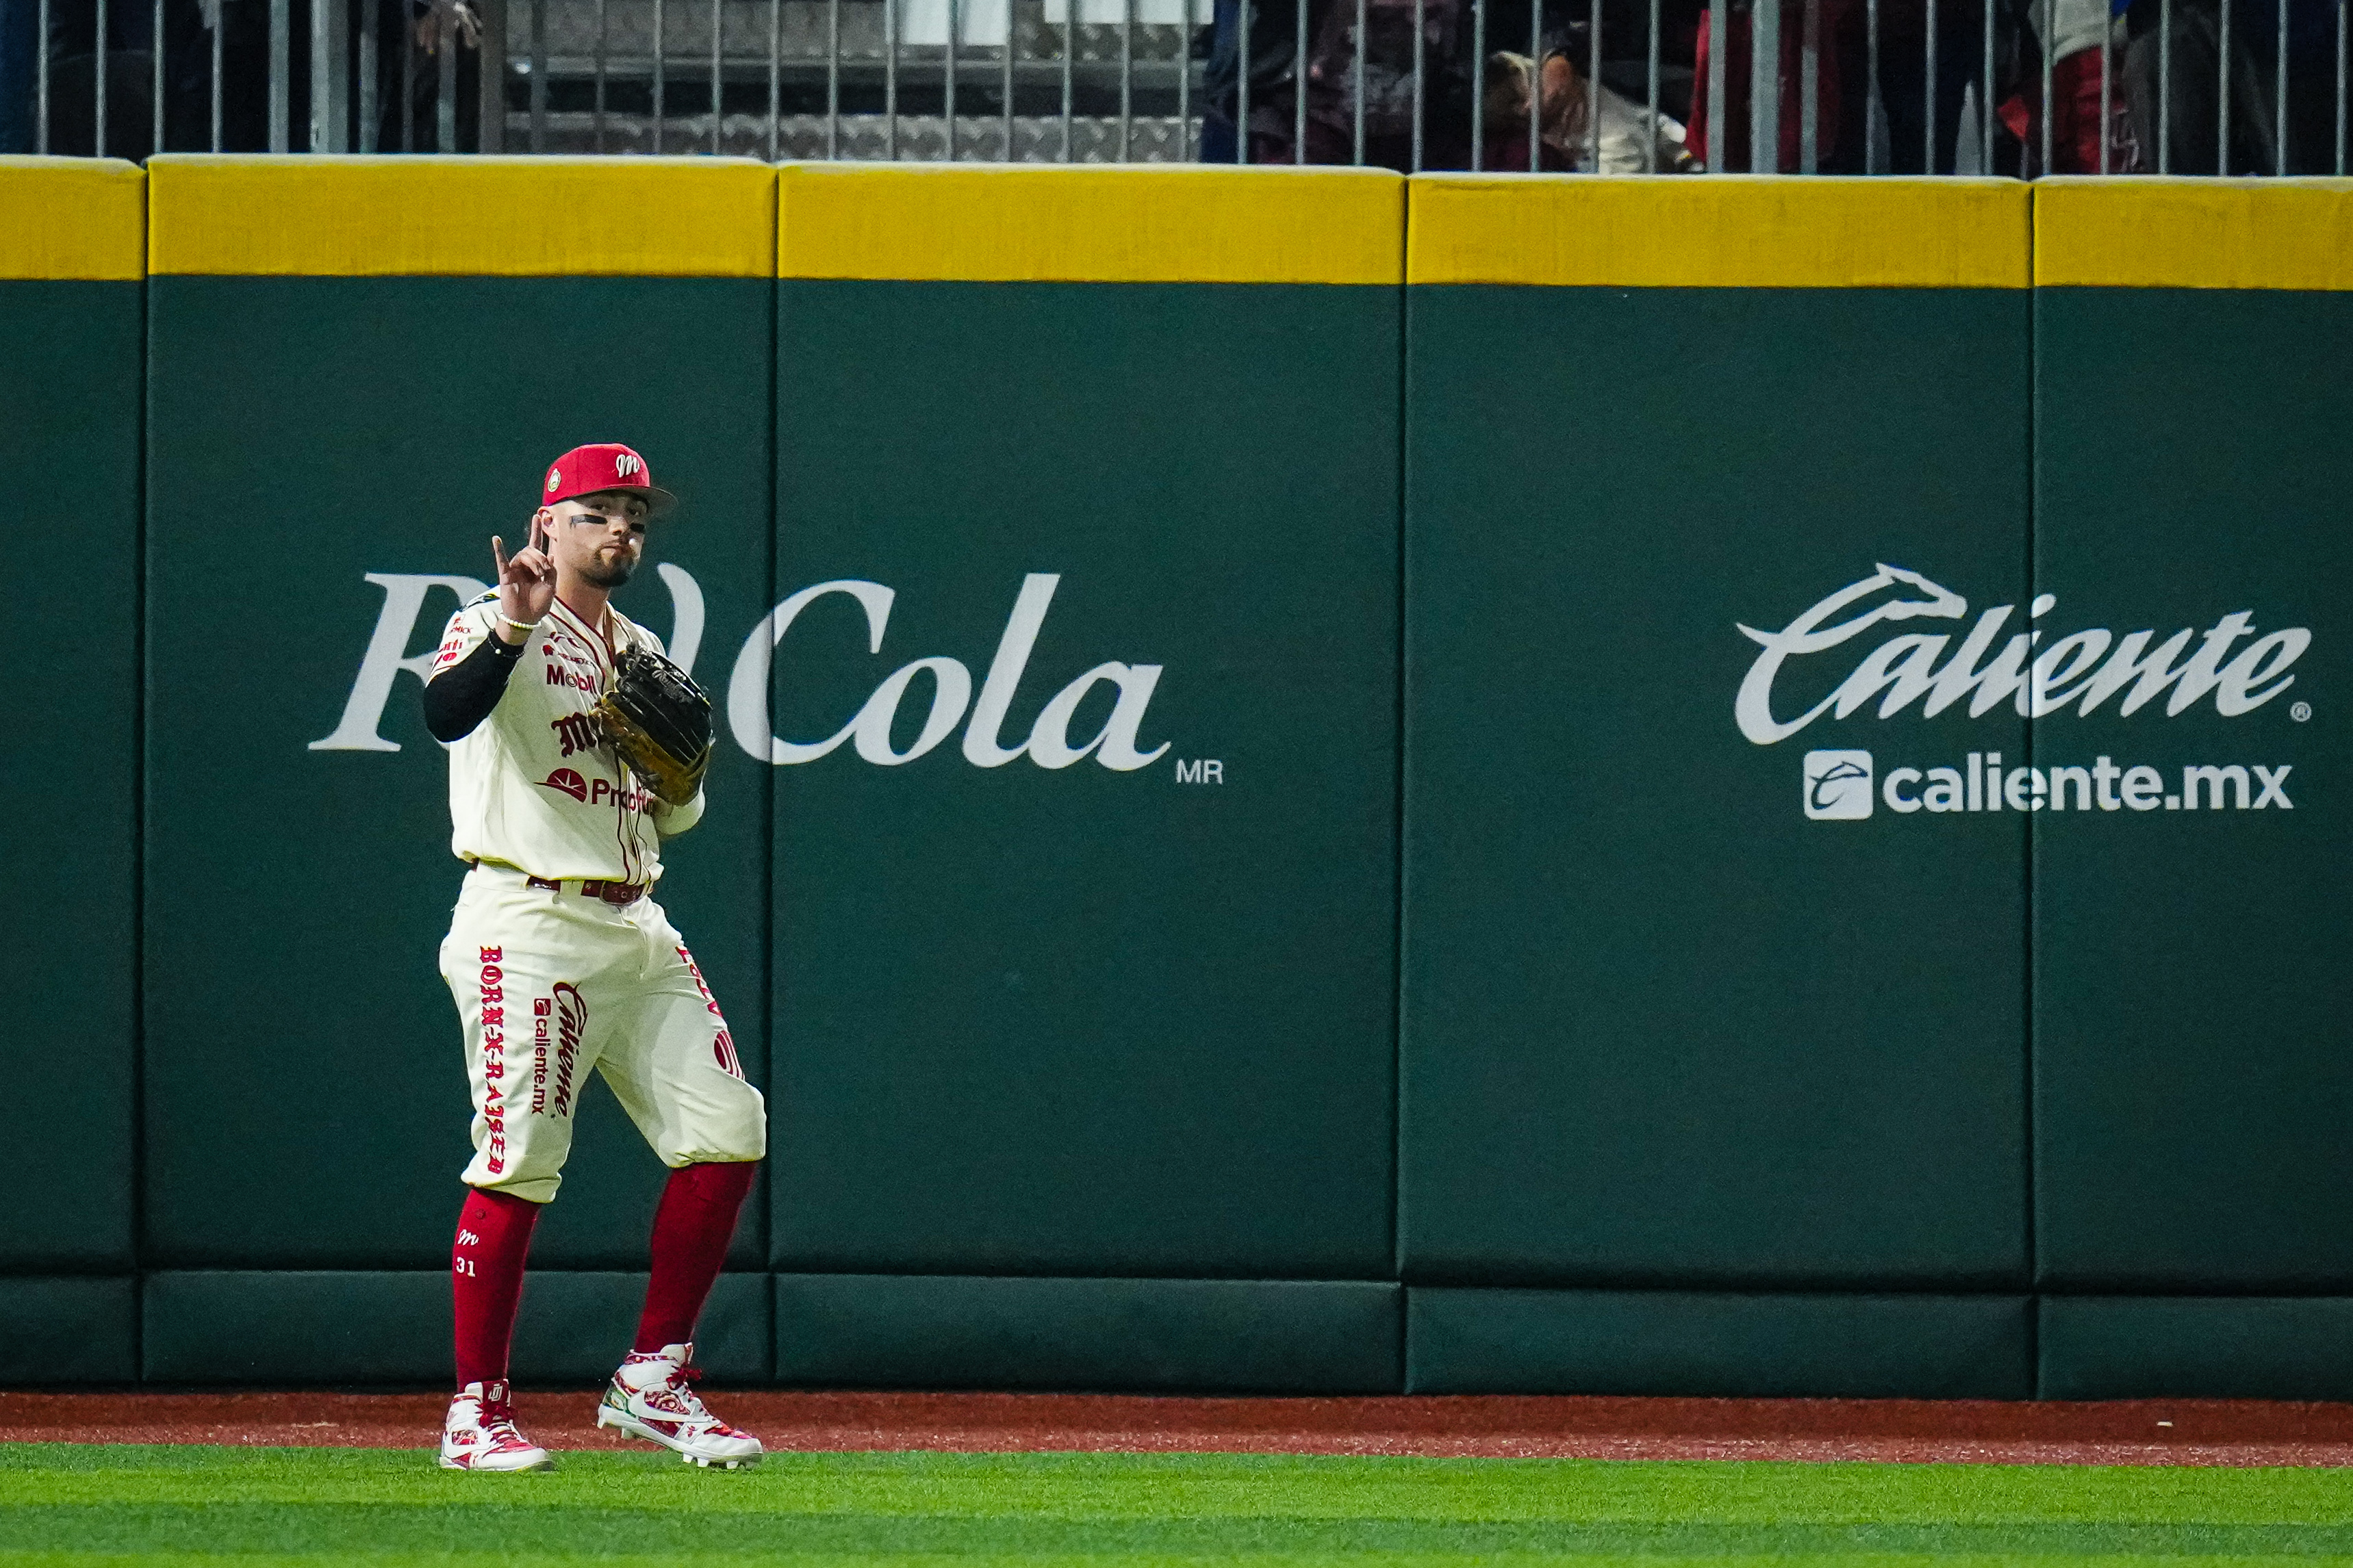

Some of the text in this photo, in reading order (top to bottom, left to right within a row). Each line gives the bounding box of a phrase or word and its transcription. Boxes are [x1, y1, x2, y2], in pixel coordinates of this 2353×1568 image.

[546, 663, 598, 696] Mobil
[726, 572, 1171, 771] Cola
[1735, 562, 2312, 745] Caliente
[1175, 758, 1224, 786] MR
[1882, 751, 2293, 813] caliente.mx
[531, 1017, 552, 1115] caliente.mx
[552, 981, 588, 1118] Caliente
[456, 1257, 476, 1278] 31
